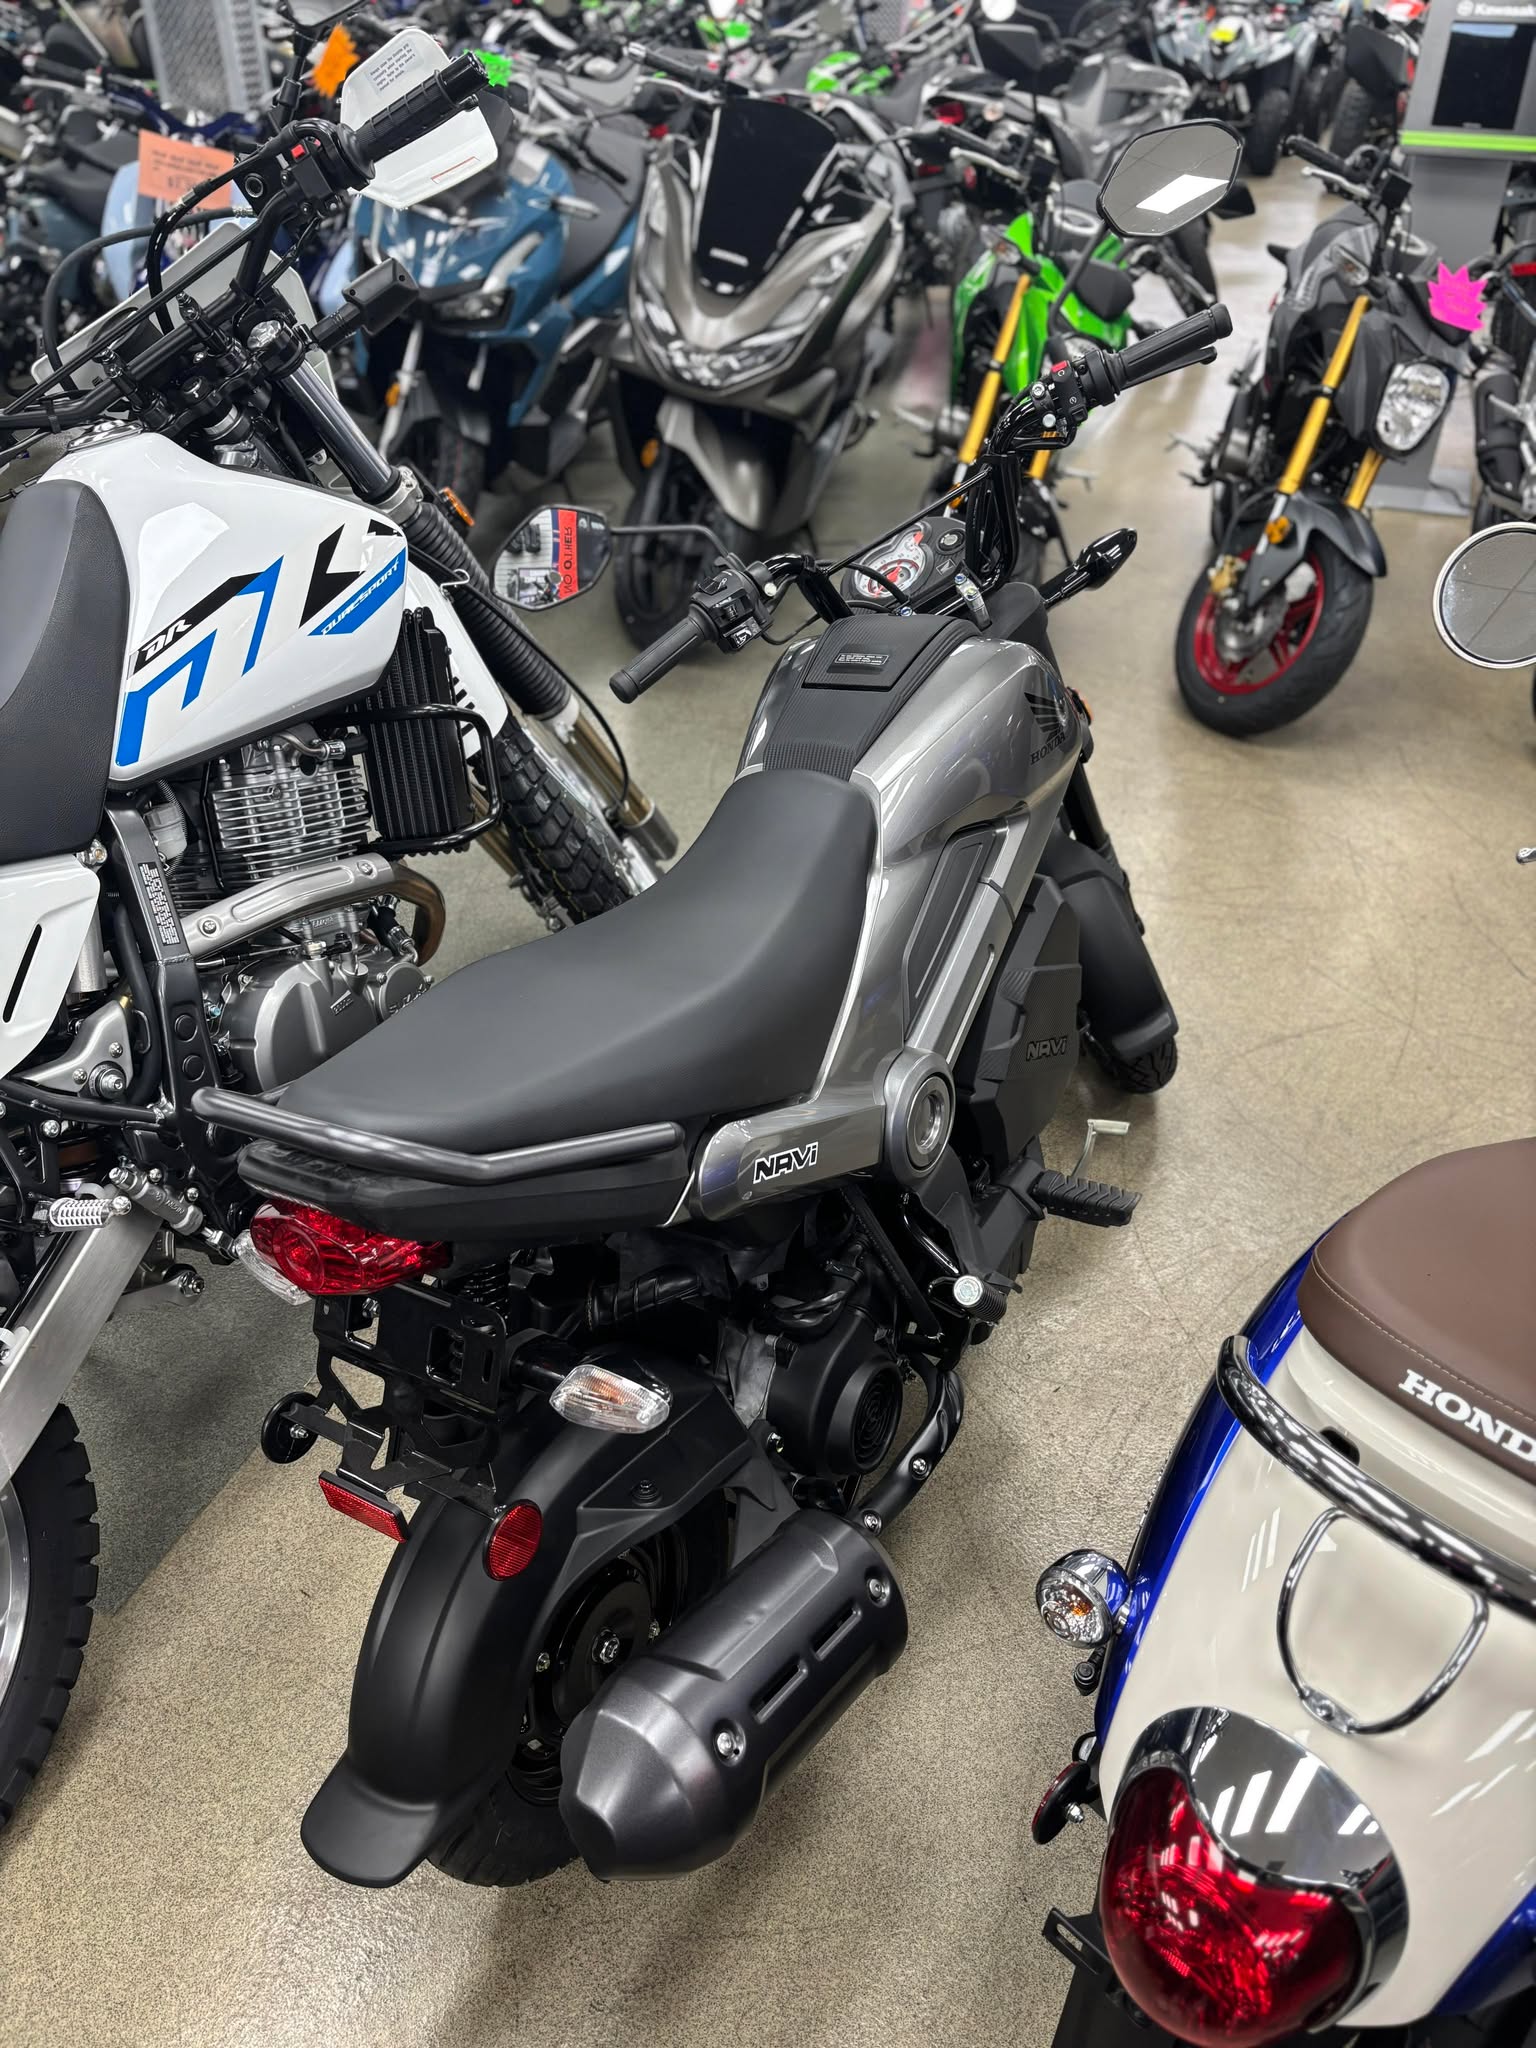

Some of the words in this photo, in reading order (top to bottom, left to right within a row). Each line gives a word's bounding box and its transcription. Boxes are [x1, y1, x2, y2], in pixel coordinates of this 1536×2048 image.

[1475, 3, 1536, 16] Kawasak
[141, 619, 192, 662] DR
[1030, 731, 1066, 765] HONDA
[1398, 1368, 1536, 1465] HOND
